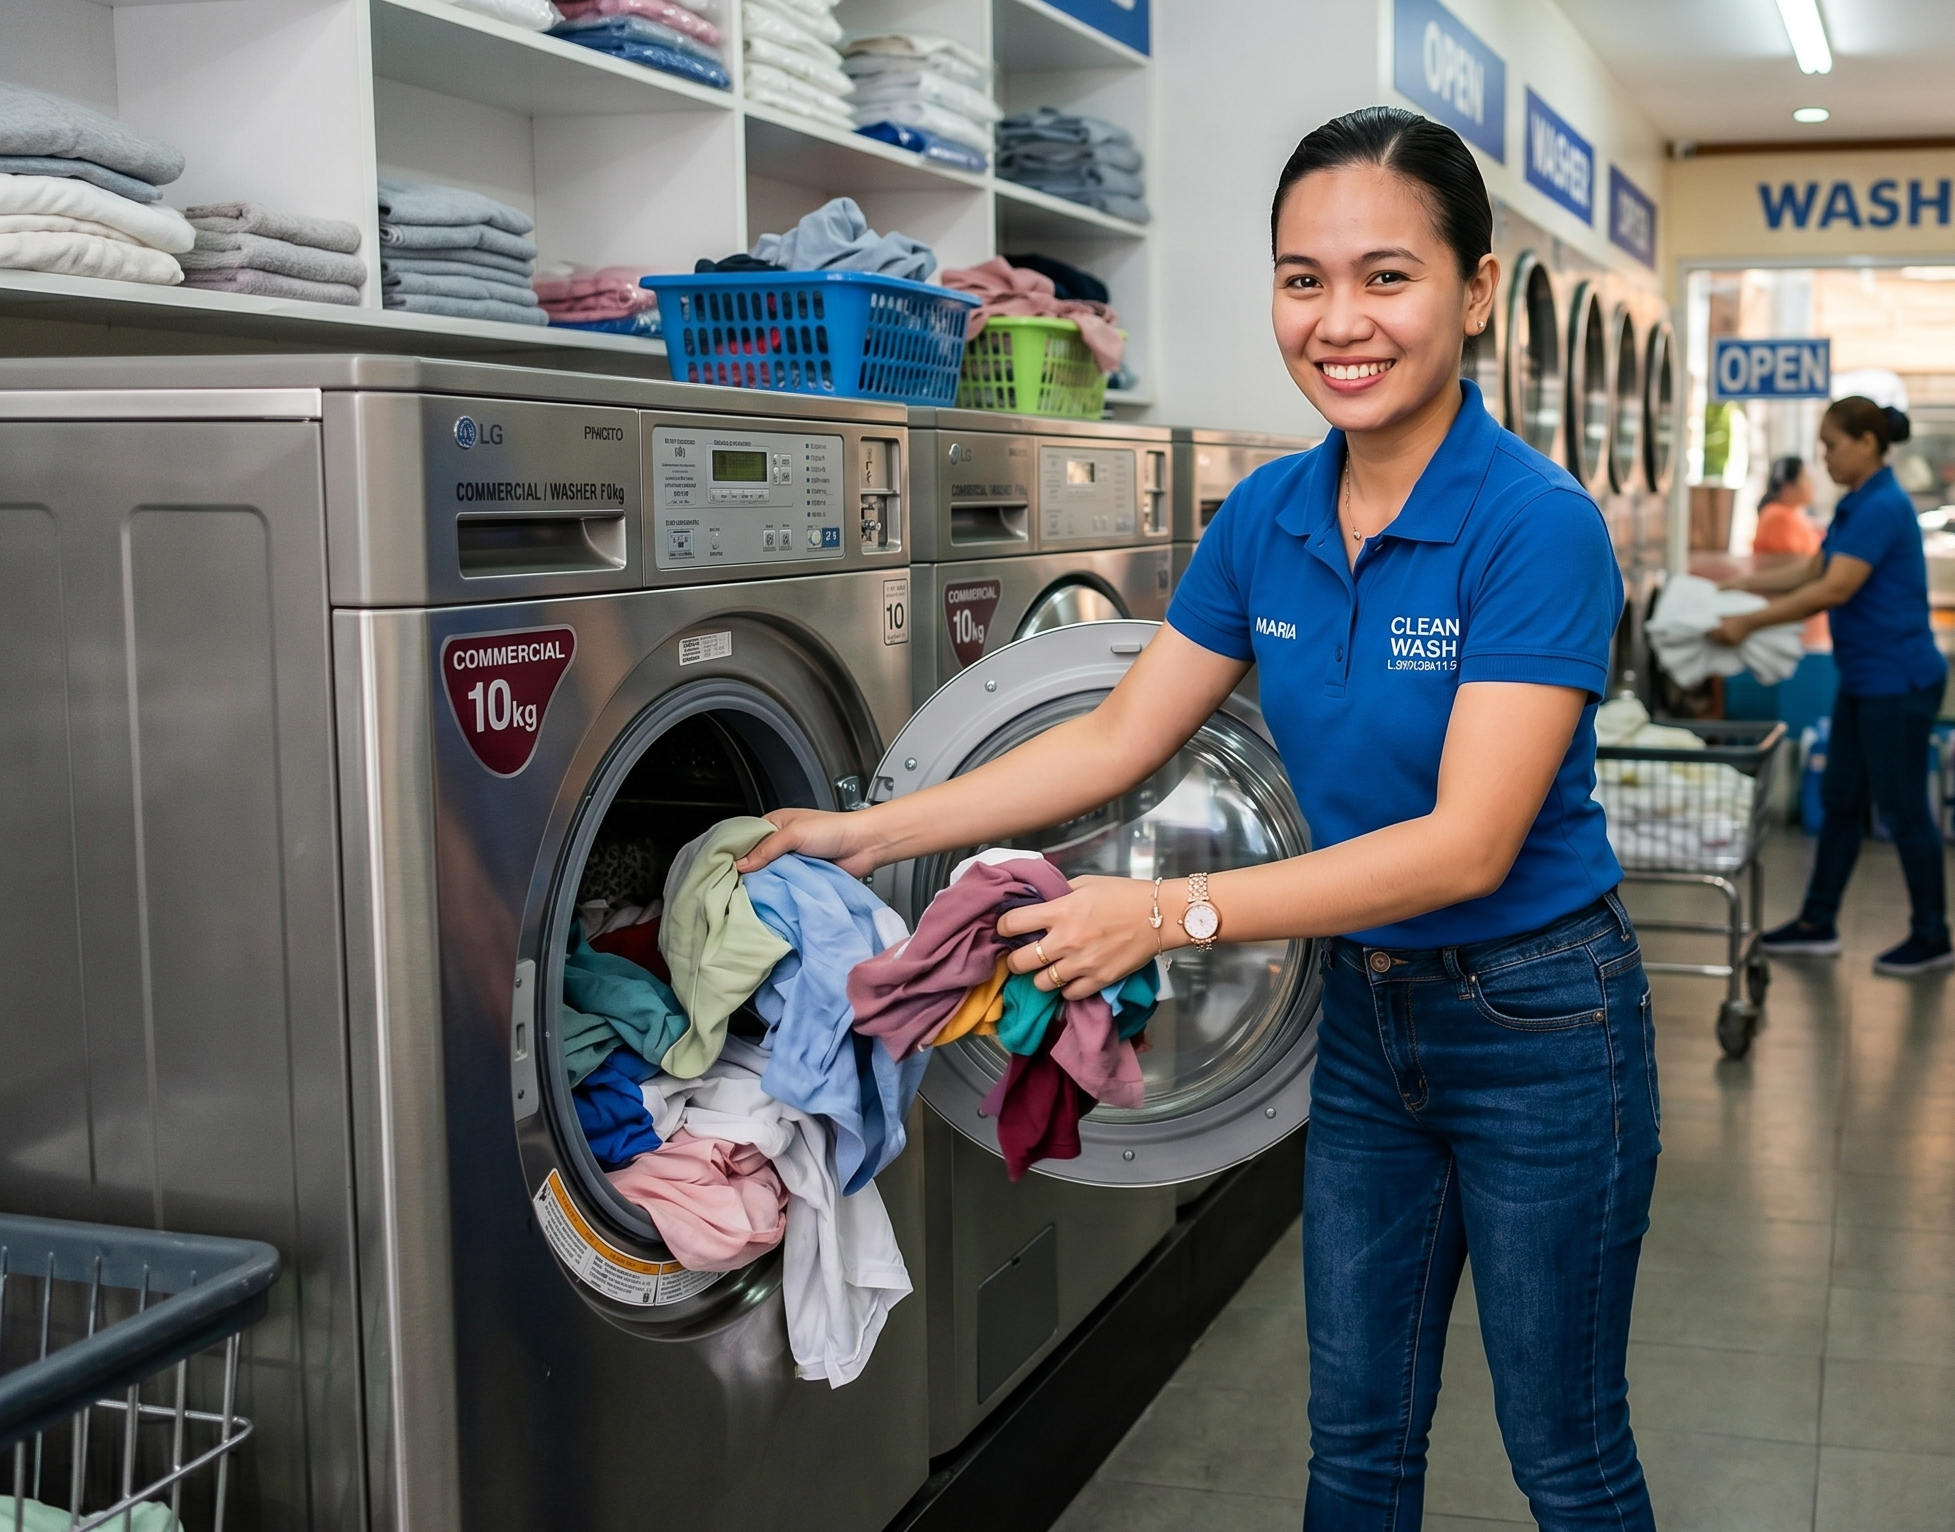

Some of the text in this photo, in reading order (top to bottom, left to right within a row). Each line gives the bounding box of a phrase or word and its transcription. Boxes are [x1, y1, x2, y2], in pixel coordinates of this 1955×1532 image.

[1423, 18, 1485, 127] OPEN
[1757, 178, 1953, 231] WASH
[1719, 344, 1828, 394] OPEN
[479, 423, 504, 445] LG
[456, 482, 542, 501] COMMERCIAL
[550, 482, 598, 501] WASHER
[886, 602, 905, 631] 10
[1255, 616, 1297, 640] MARIA
[1390, 616, 1460, 637] CLEAN
[453, 640, 566, 671] COMMERCIAL
[1390, 637, 1457, 658] WASH
[467, 678, 538, 733] 10kg
